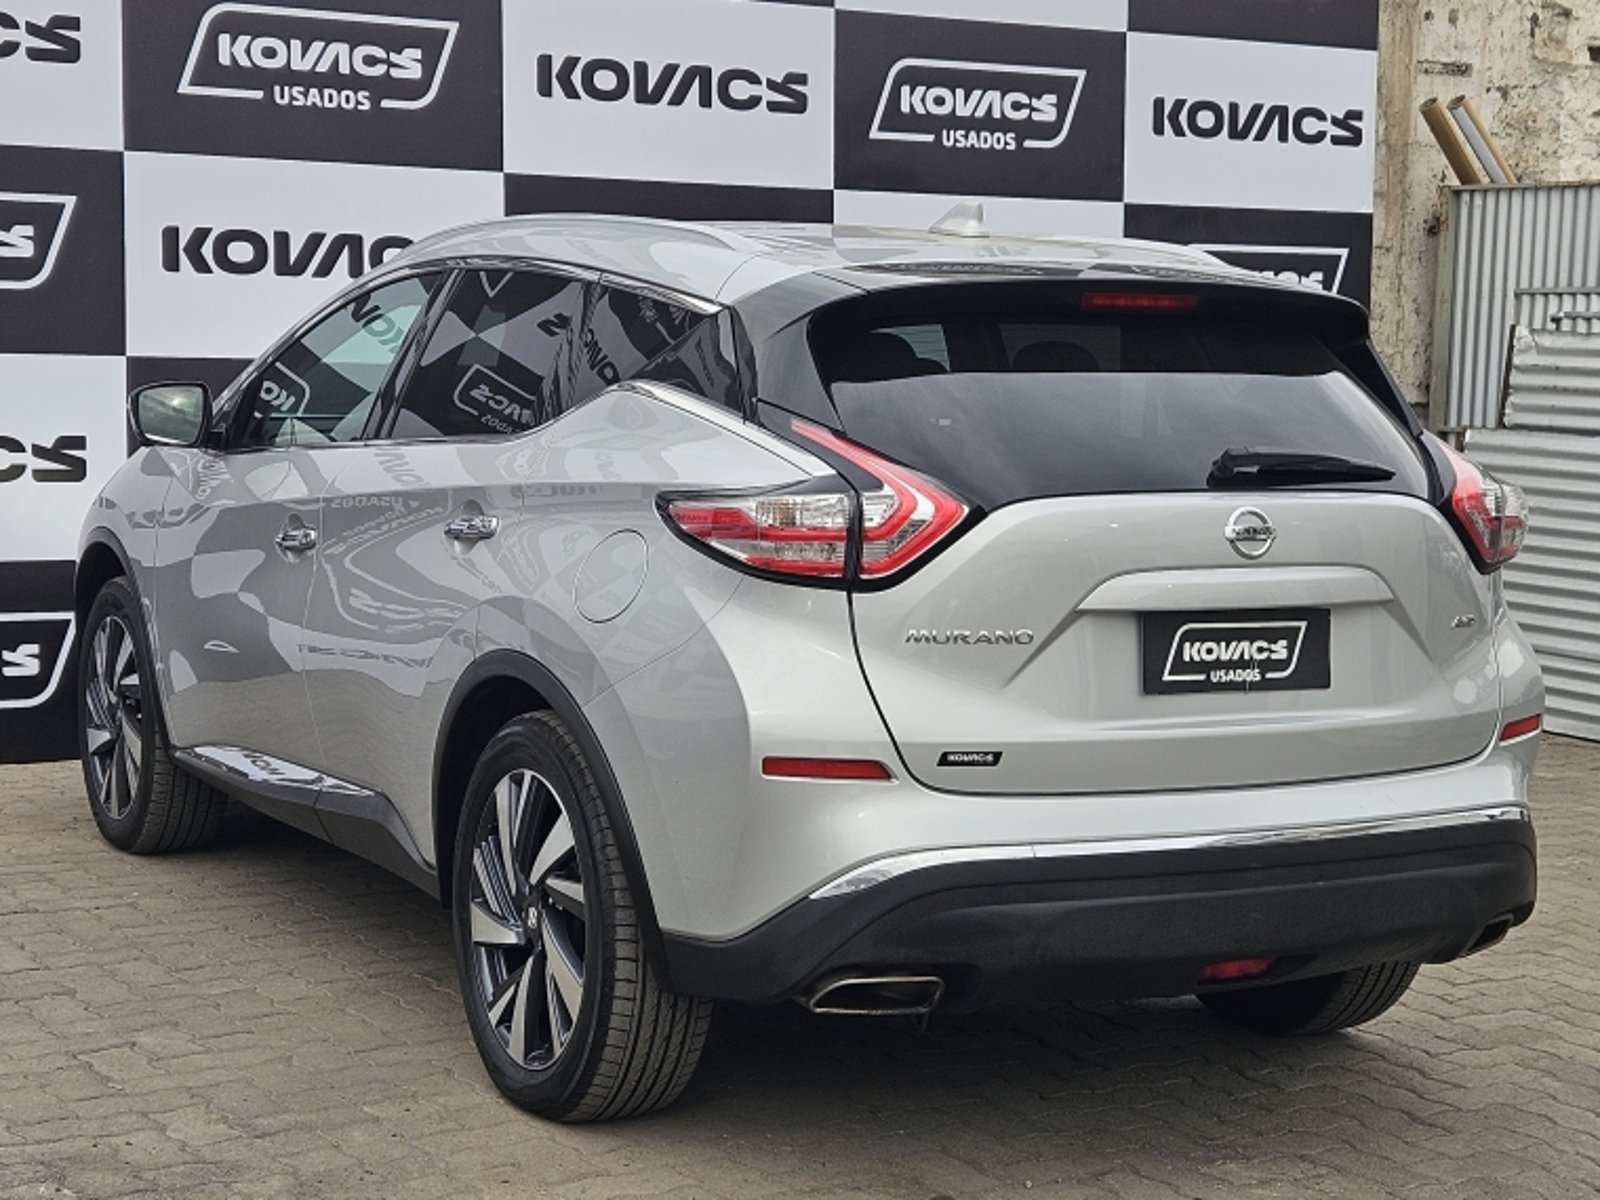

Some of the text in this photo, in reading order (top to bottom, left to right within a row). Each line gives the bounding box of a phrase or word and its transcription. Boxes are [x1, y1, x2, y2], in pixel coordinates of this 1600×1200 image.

[217, 33, 423, 79] KOVACS
[536, 53, 808, 115] KOVACS
[273, 85, 371, 111] USADOS
[900, 84, 1058, 123] KOVACS
[1152, 96, 1364, 147] KOVACS
[942, 128, 1016, 150] USADOS
[904, 629, 1034, 645] MURANO
[1182, 639, 1289, 662] KOVACS
[1210, 668, 1262, 683] USADOS
